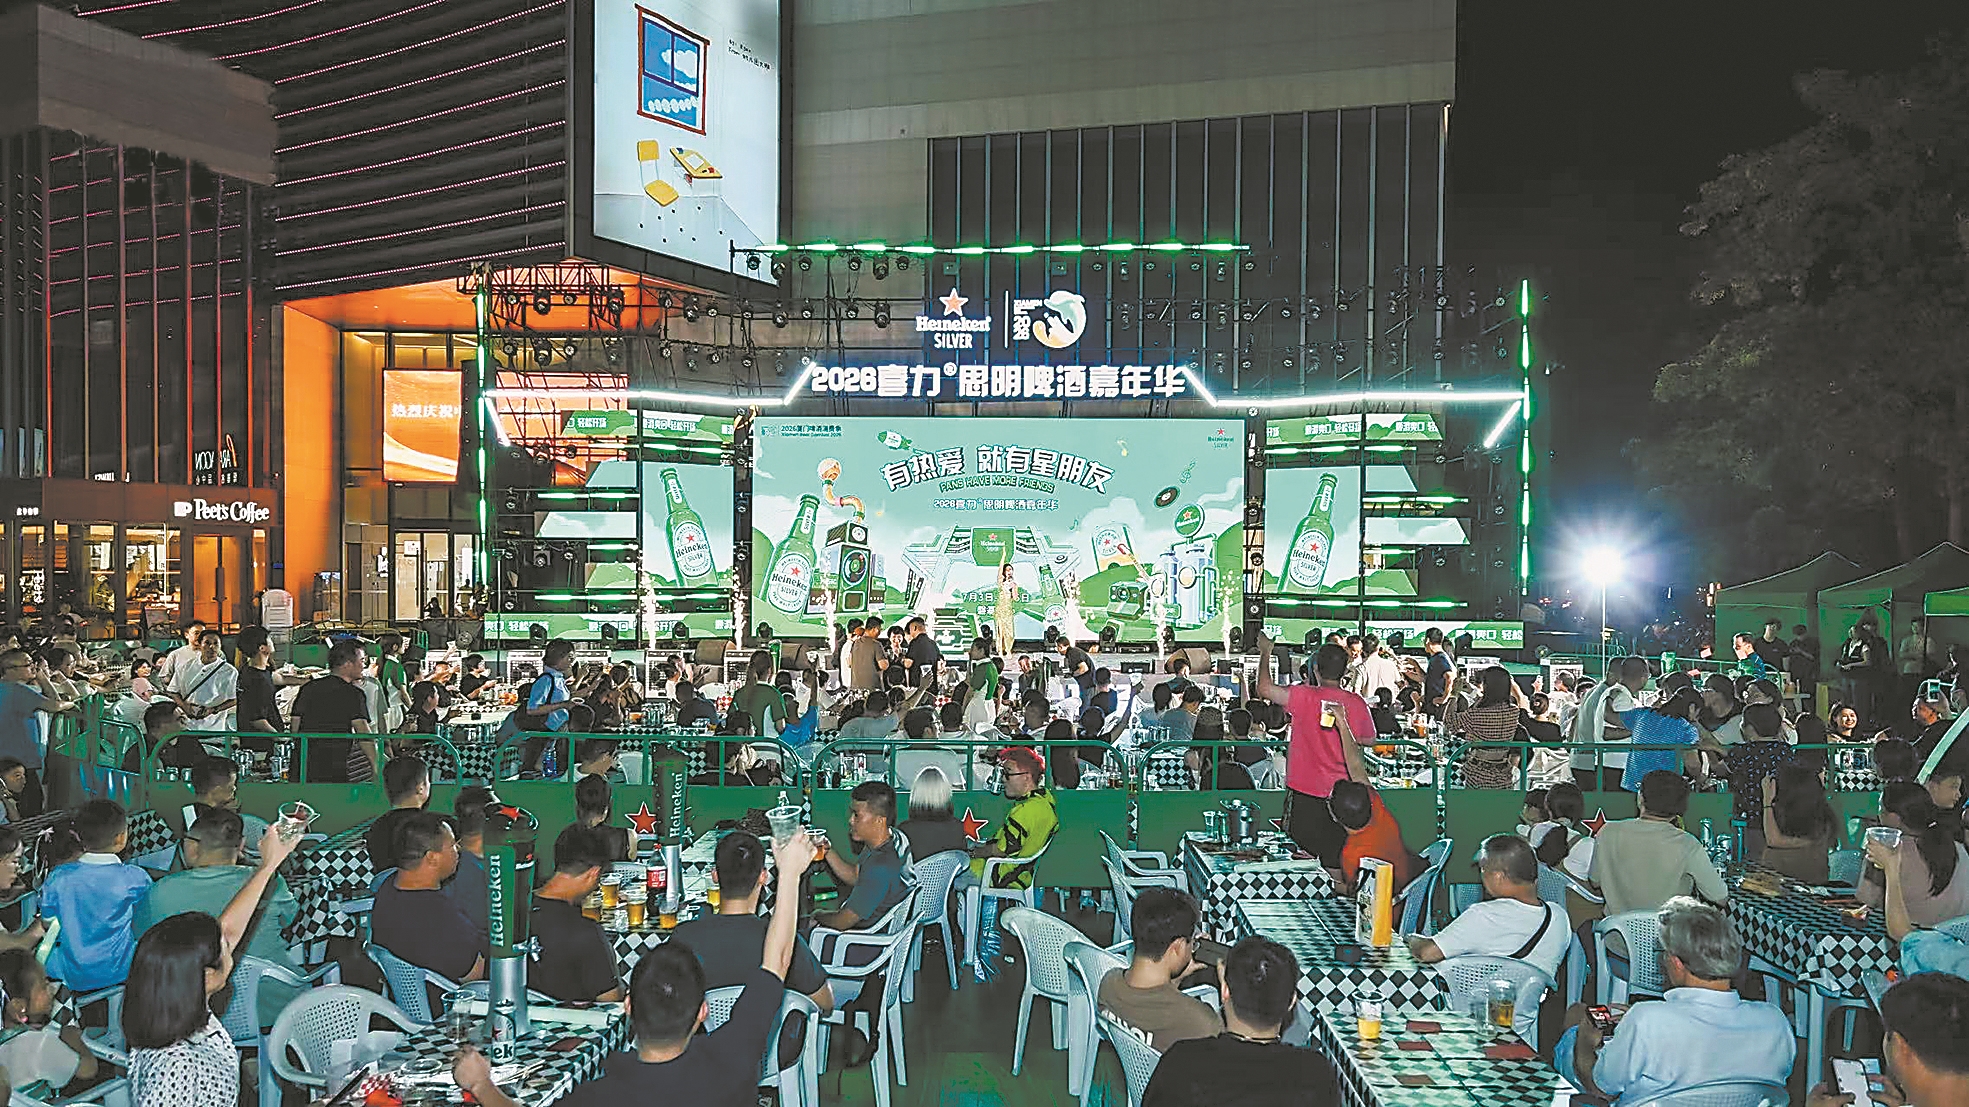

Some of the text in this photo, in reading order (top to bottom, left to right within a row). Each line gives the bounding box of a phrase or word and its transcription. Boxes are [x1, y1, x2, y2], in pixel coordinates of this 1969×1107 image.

[916, 316, 992, 332] Heineken
[934, 333, 973, 349] SILVER
[881, 446, 1115, 494] 有热爱 就有星朋友
[940, 475, 1055, 493] FANS HAVE MORE FRIENDS
[193, 499, 270, 523] Peet's Coffee
[669, 772, 683, 838] Heineken
[488, 854, 505, 947] Heineken
